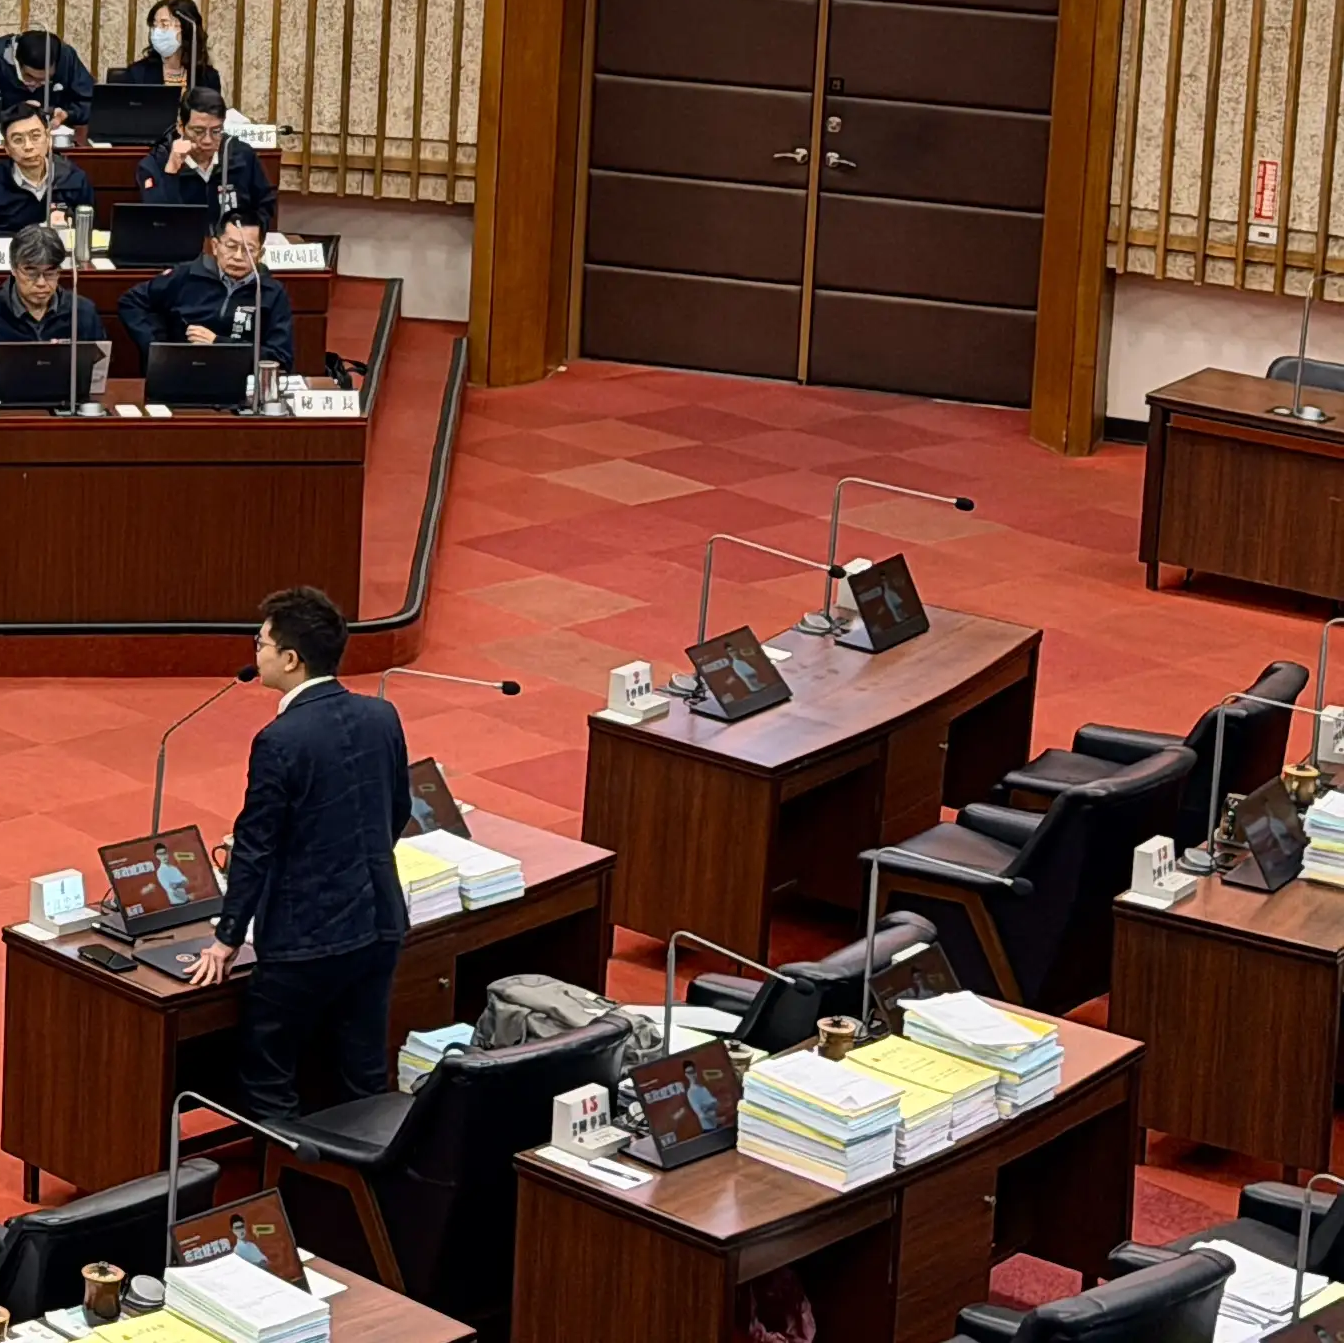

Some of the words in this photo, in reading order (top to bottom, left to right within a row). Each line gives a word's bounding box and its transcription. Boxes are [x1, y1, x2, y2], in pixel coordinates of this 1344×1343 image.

[269, 250, 320, 266] 財政局長
[301, 396, 354, 411] 秘書長
